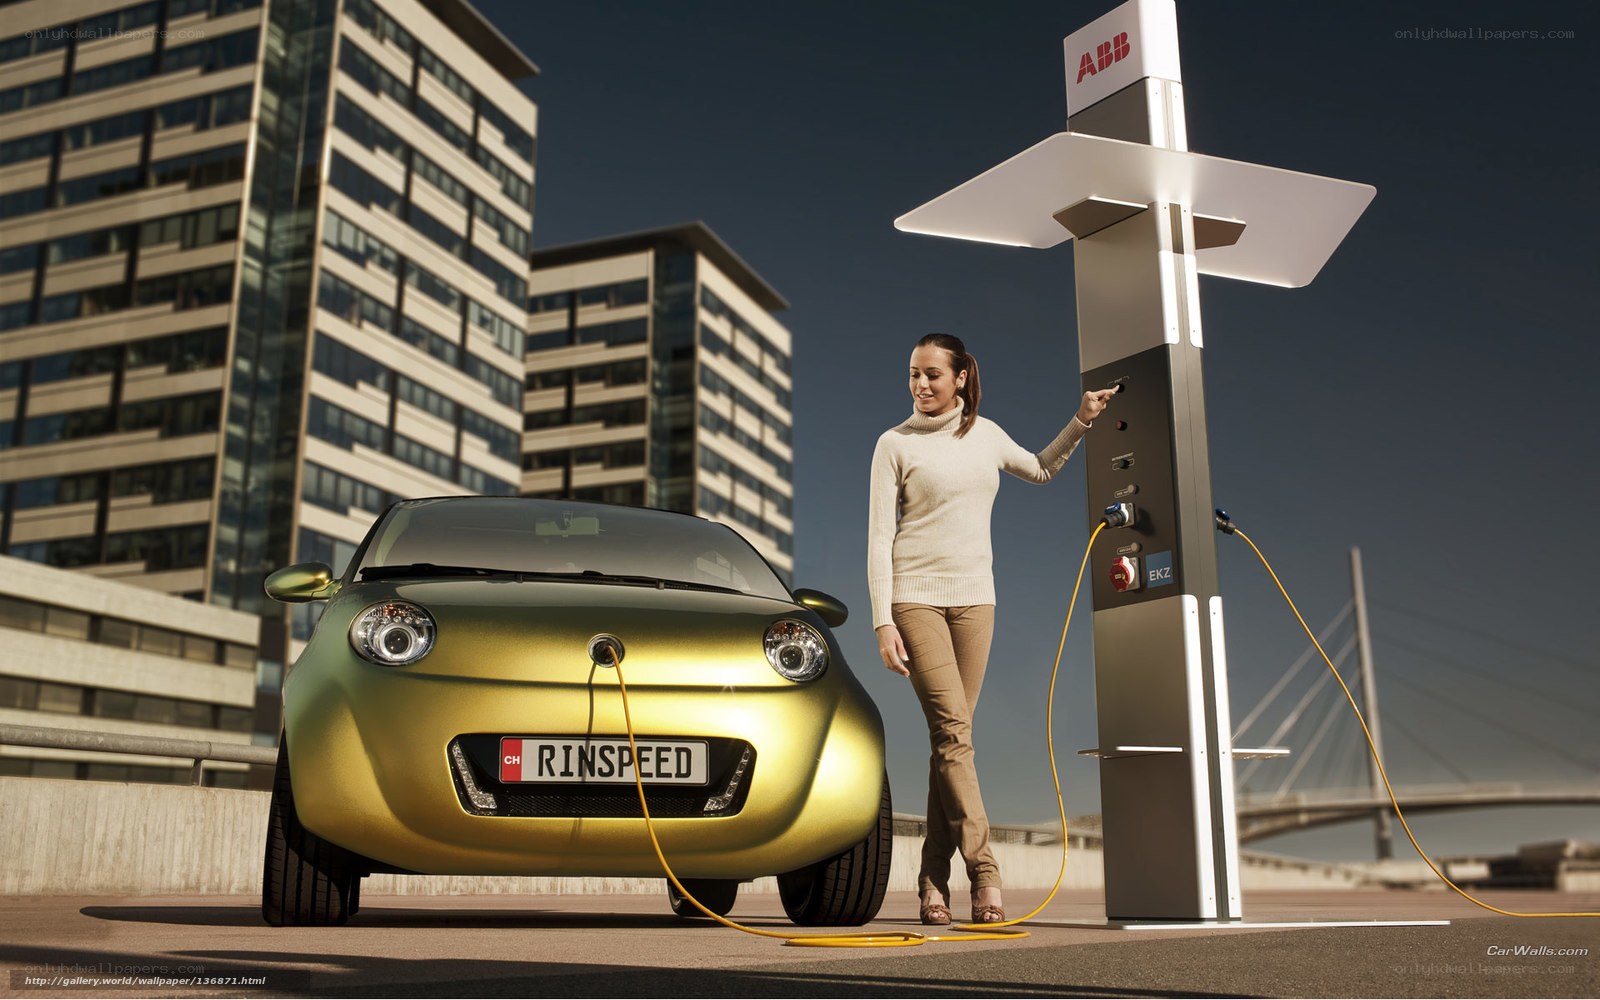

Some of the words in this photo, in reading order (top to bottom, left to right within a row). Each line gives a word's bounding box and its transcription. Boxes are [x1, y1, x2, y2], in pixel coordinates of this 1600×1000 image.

[1076, 31, 1130, 85] ABB
[1149, 566, 1171, 581] EKZ
[504, 756, 521, 765] CH
[537, 744, 692, 779] RINSPEED
